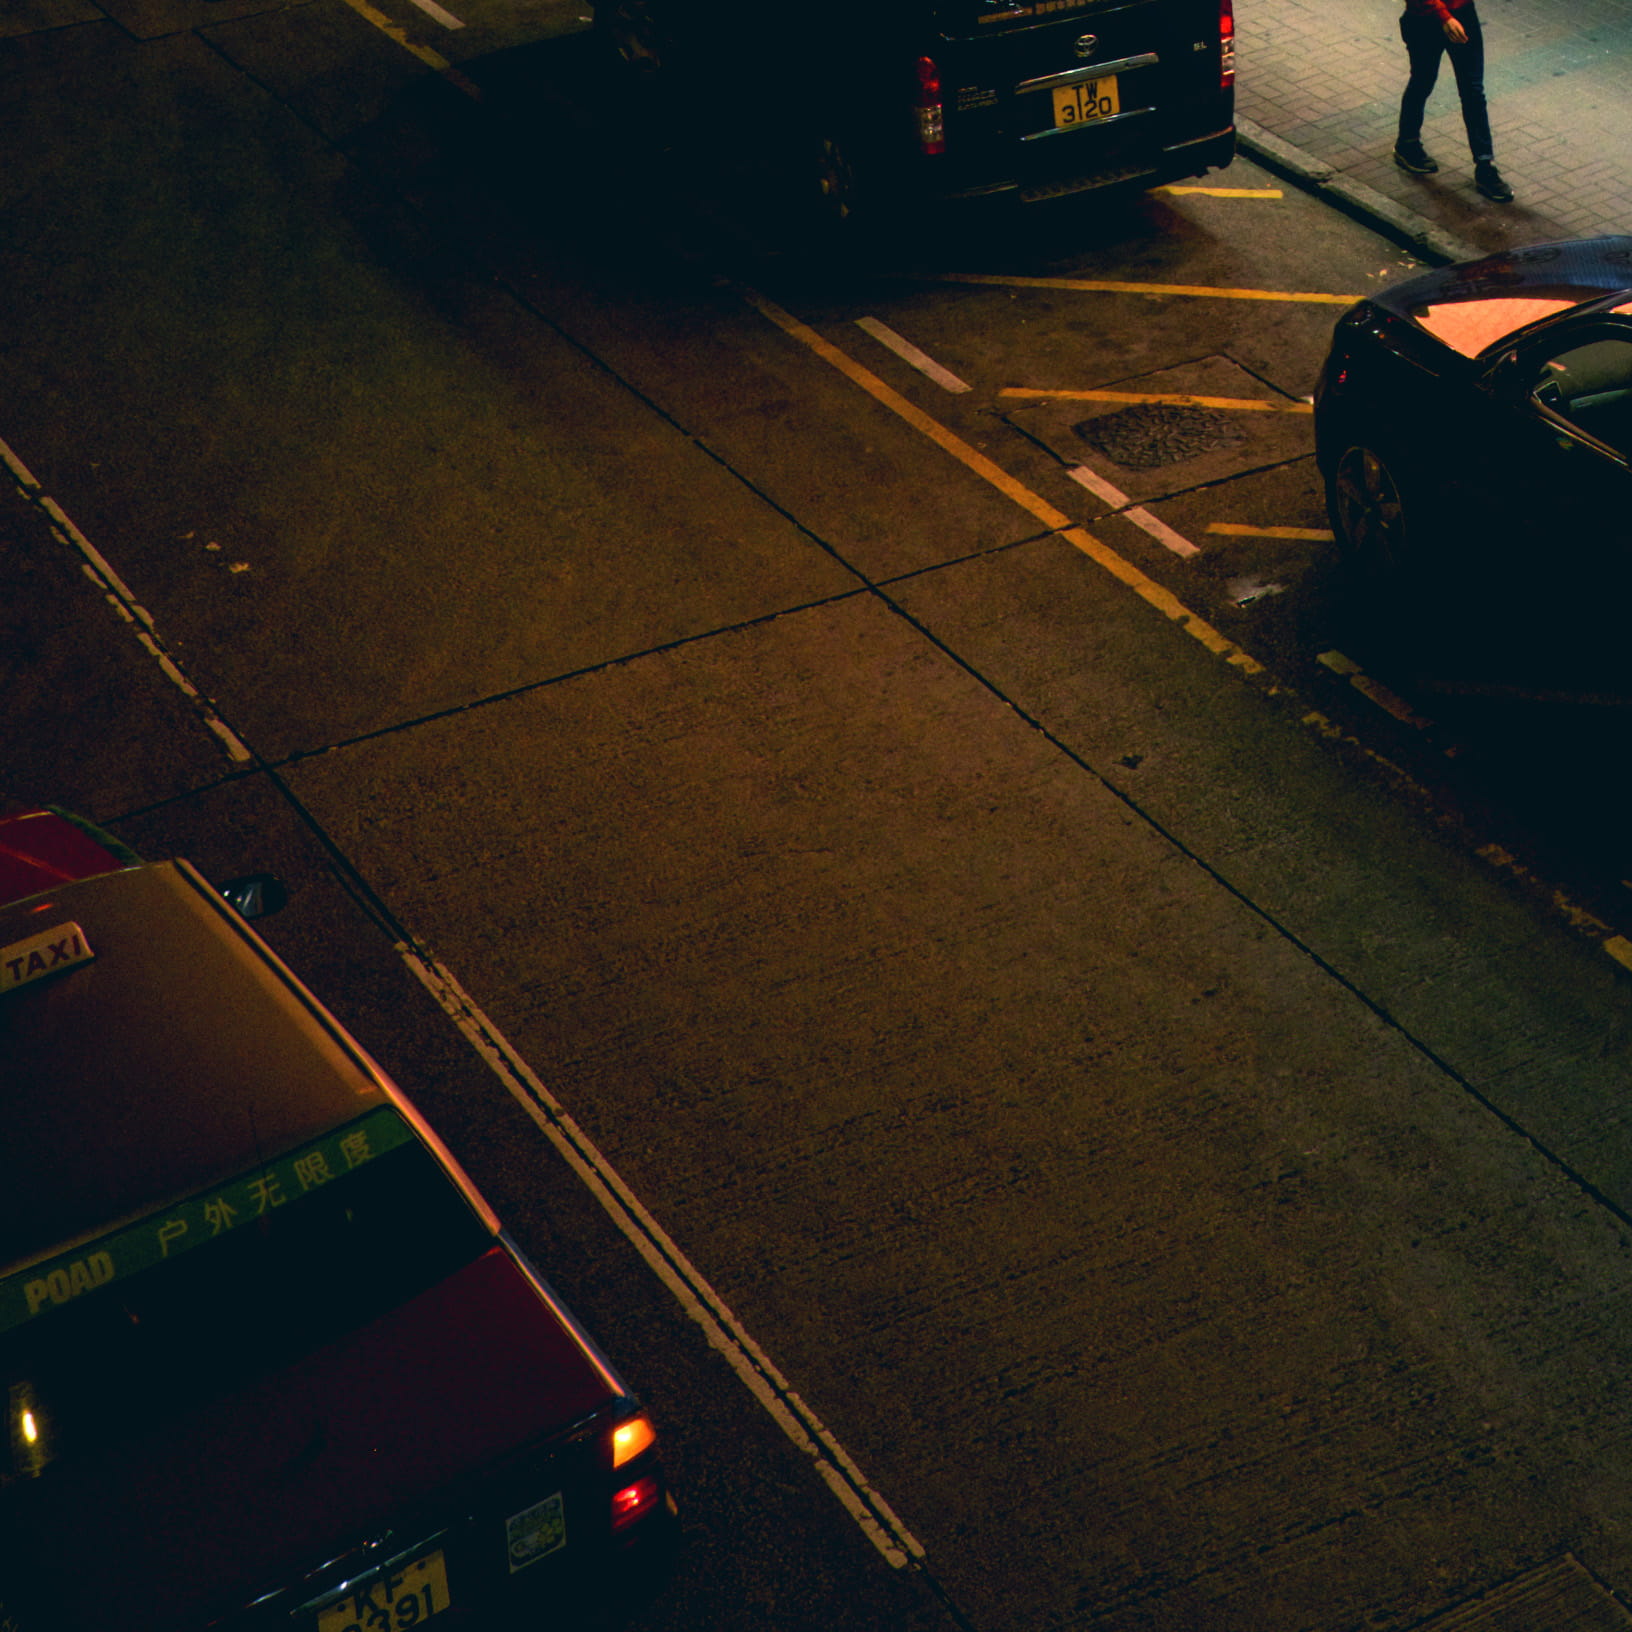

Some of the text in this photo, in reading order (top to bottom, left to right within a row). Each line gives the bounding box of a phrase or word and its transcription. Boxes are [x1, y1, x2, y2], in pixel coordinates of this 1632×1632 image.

[6, 935, 82, 981] TAXI
[23, 1249, 117, 1316] POAD
[352, 1574, 407, 1620] KF
